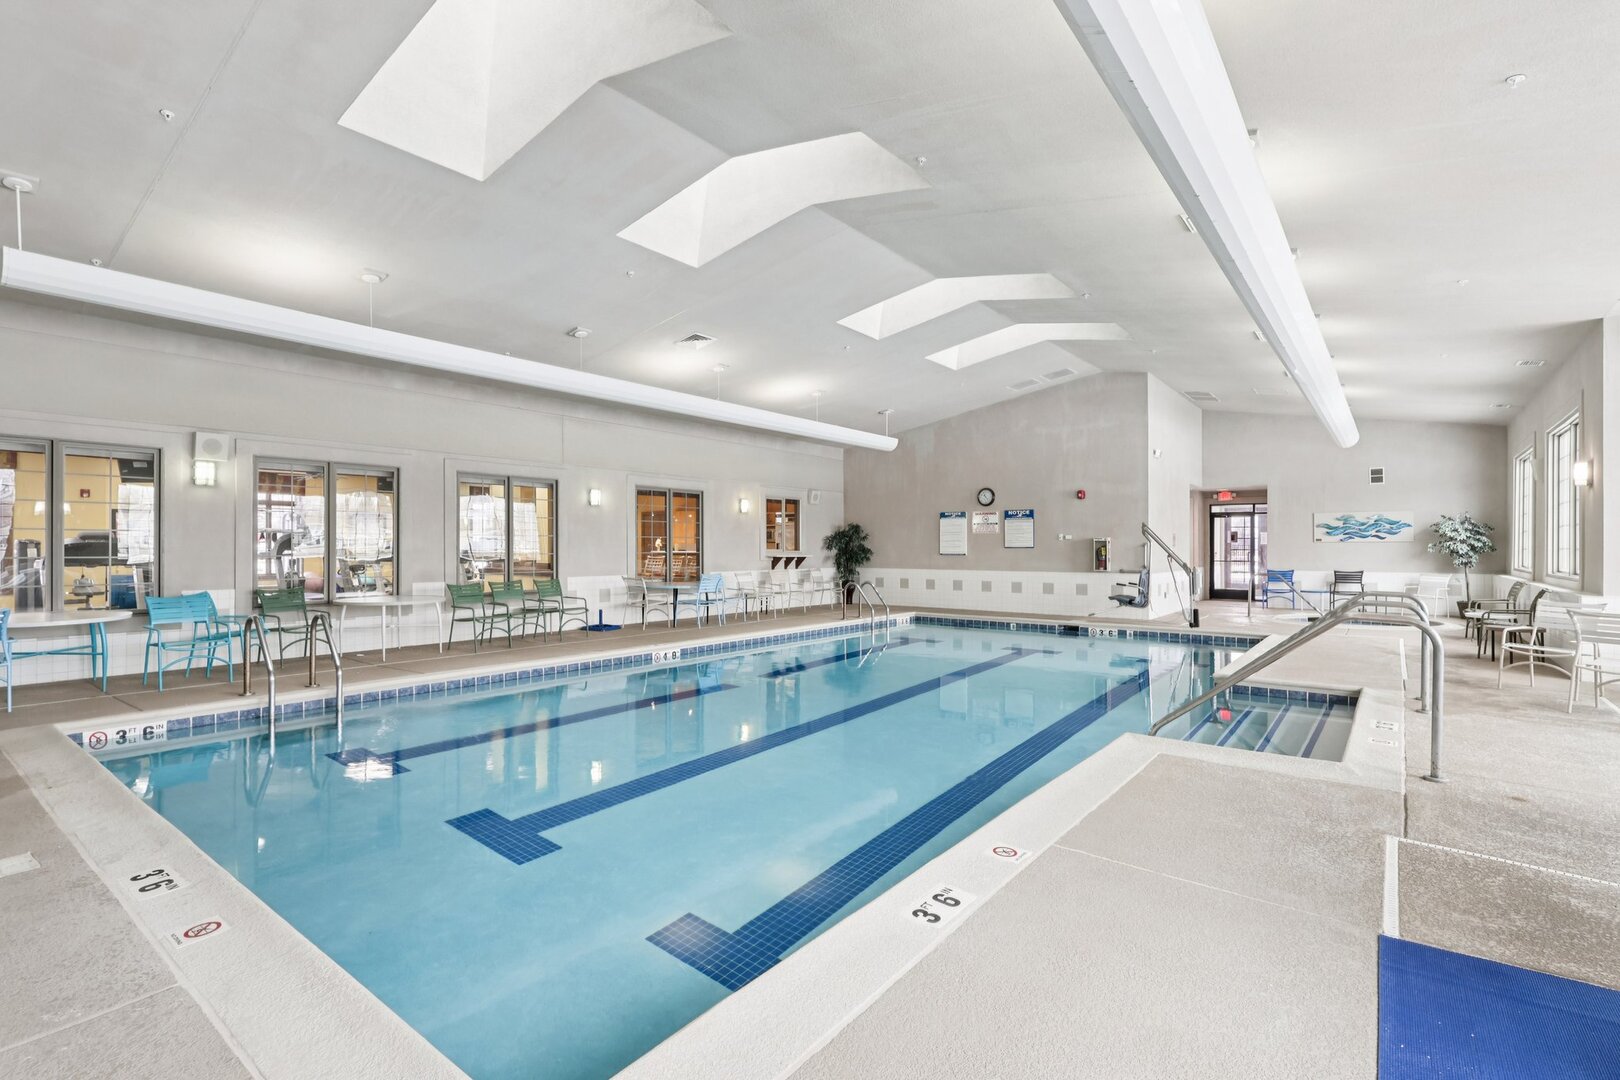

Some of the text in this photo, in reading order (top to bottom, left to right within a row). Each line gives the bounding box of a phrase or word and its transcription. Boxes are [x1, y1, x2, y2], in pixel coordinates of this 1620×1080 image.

[115, 729, 127, 745] 3
[129, 868, 165, 882] 3
[138, 878, 174, 893] 6
[919, 901, 933, 911] FT
[932, 893, 961, 908] 6
[911, 908, 942, 924] 3
